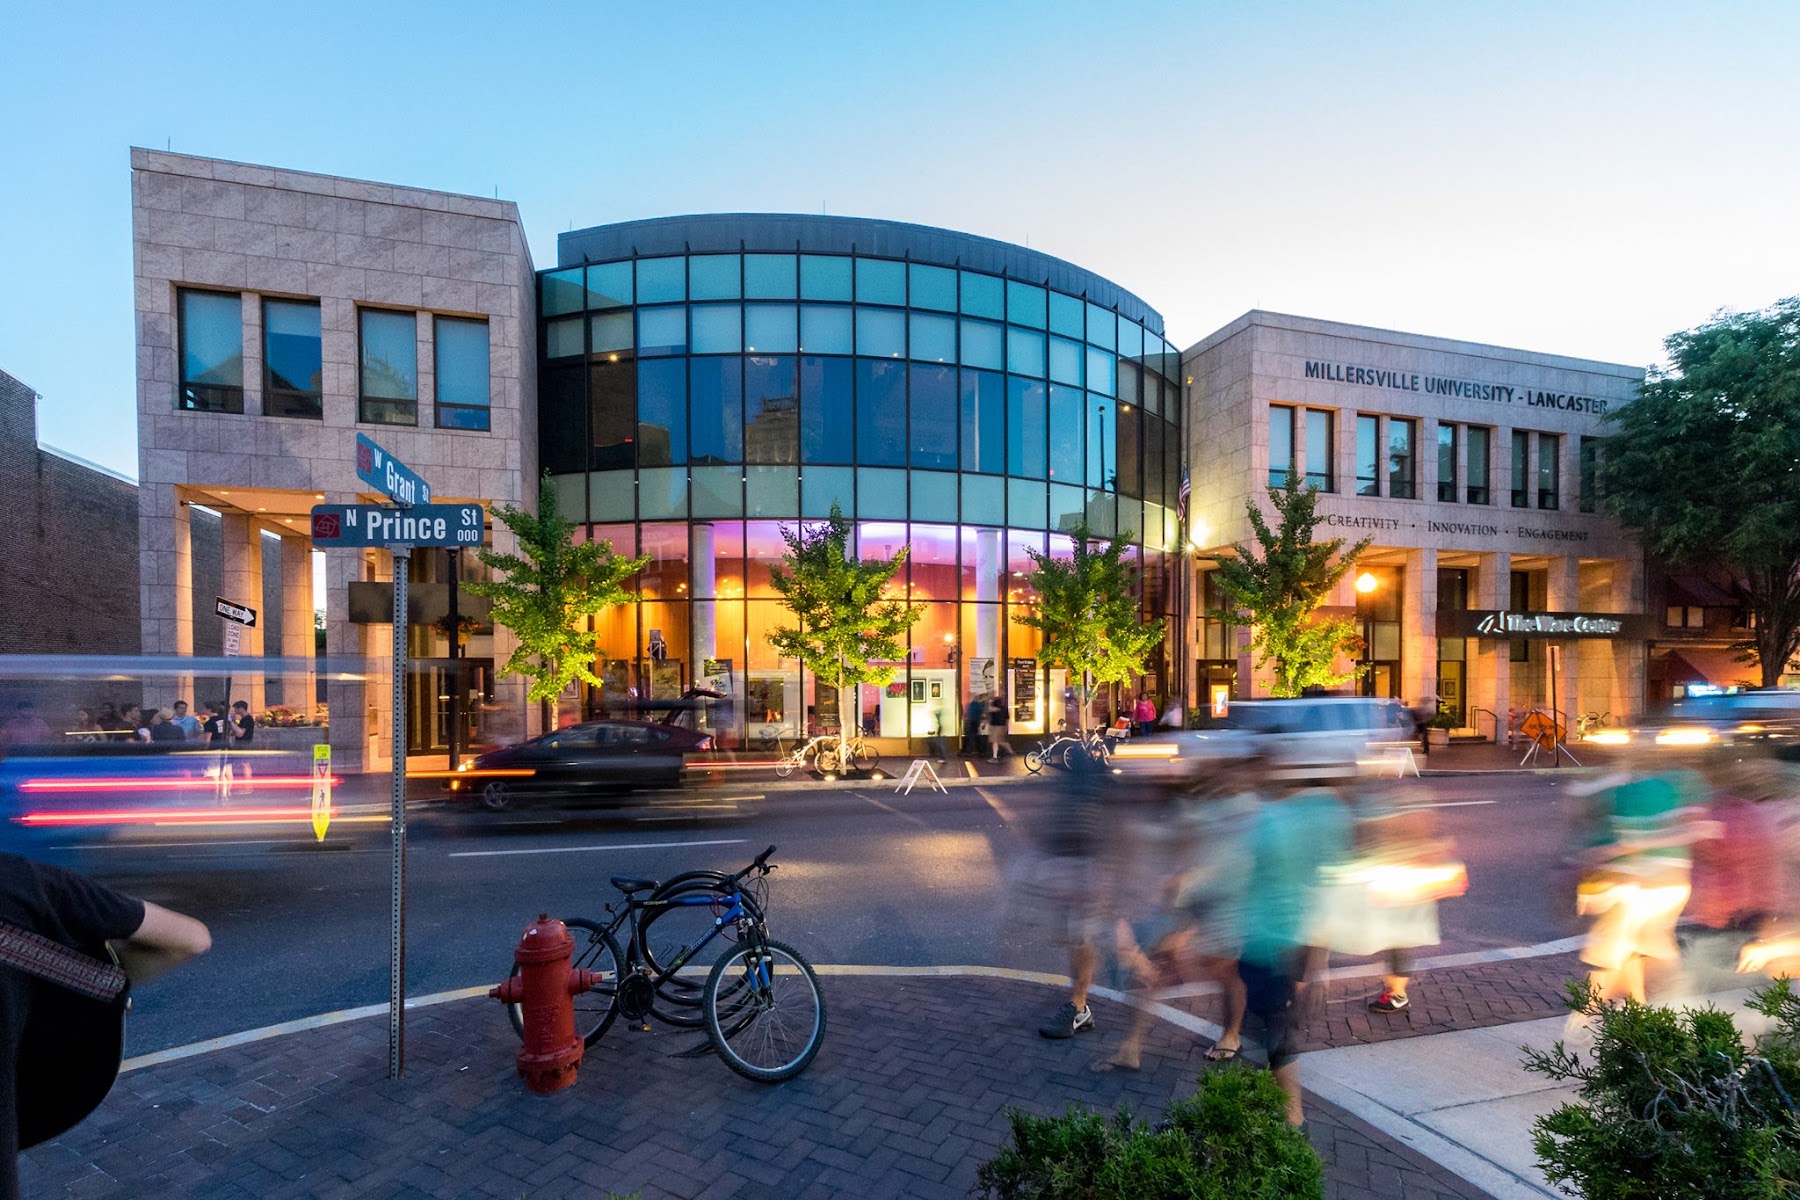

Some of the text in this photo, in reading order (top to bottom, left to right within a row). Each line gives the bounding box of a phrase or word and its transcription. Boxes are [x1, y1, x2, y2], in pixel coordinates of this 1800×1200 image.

[1305, 361, 1419, 391] MILLERSVILLE
[1425, 376, 1514, 403] UNIVERSITY
[1527, 390, 1608, 414] LANCASTER
[374, 448, 429, 505] W Grant St
[346, 508, 477, 540] N Prince St
[457, 529, 478, 542] 000
[1327, 513, 1588, 541] CREATIVITY INNOVATION ENGAGEMENT
[219, 604, 244, 618] ONE WAY
[1507, 614, 1622, 633] The Ware Center
